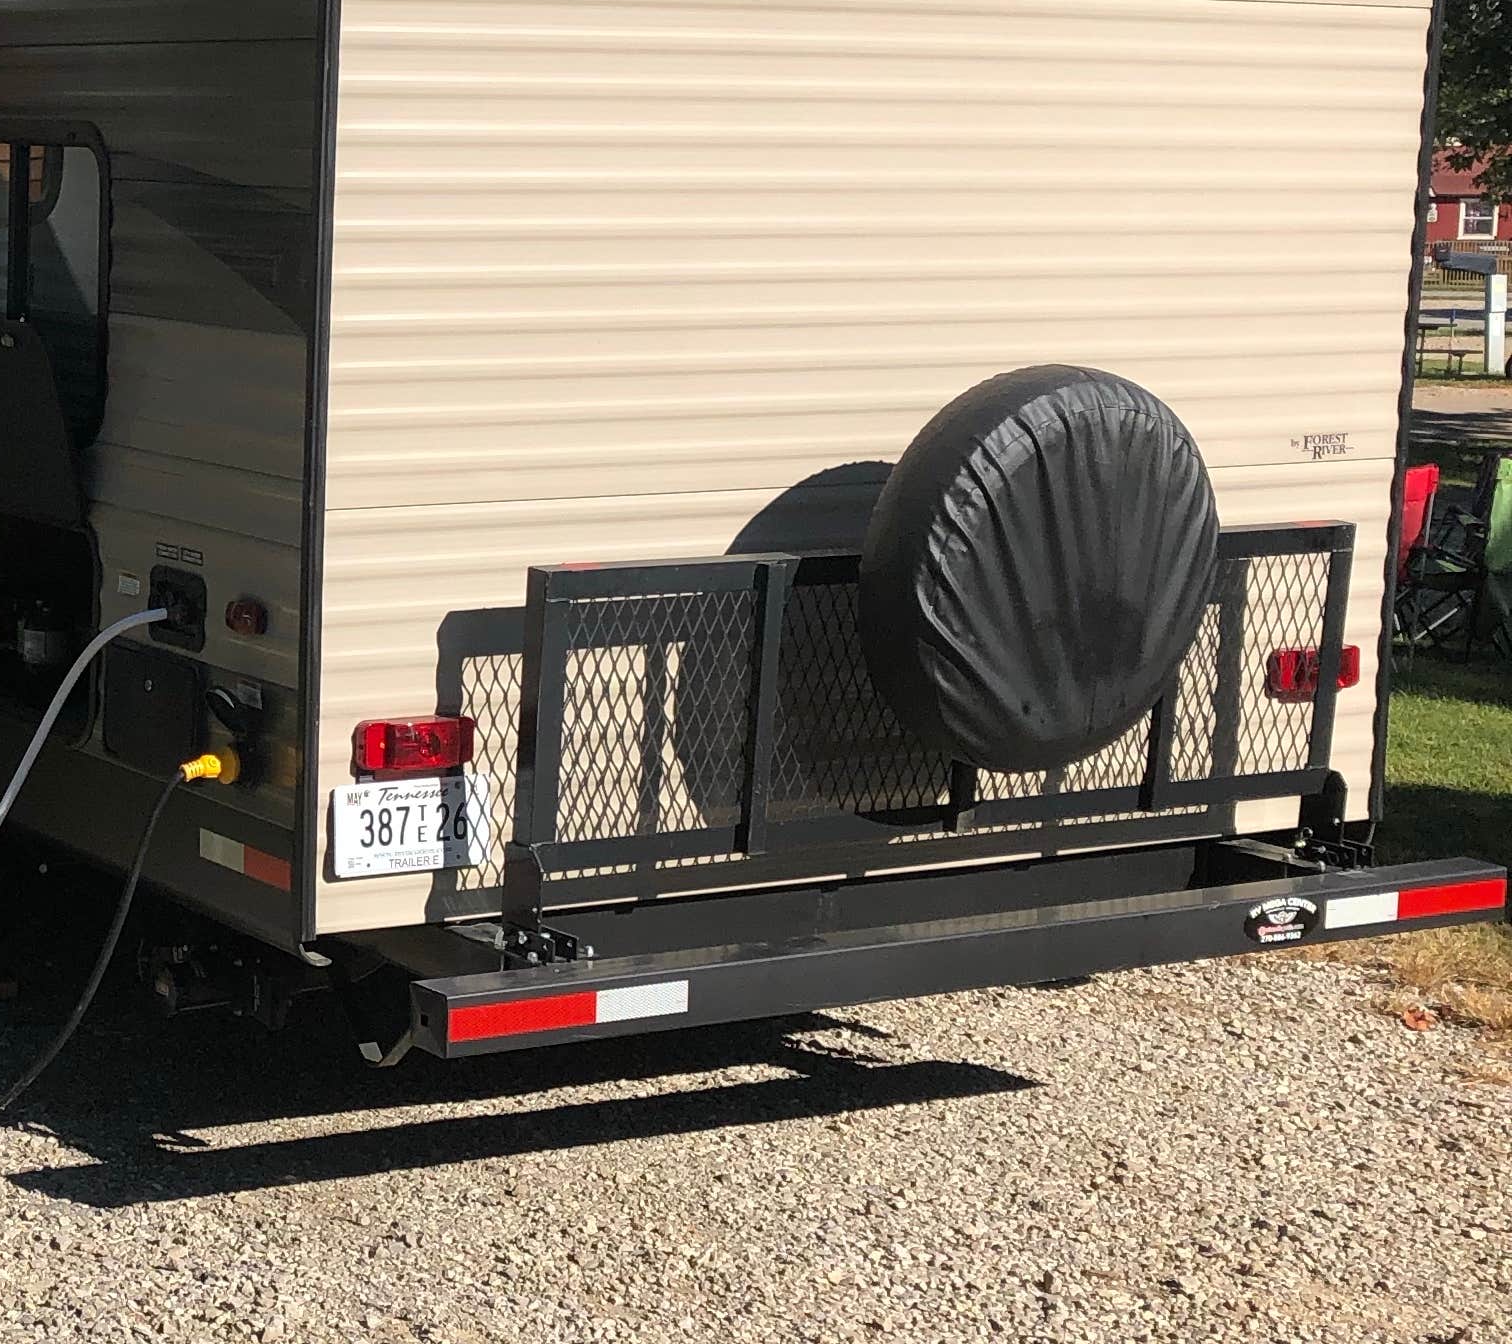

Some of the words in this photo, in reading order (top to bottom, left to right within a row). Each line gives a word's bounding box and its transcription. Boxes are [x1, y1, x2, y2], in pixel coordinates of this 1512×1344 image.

[1290, 439, 1300, 449] by
[1303, 433, 1349, 450] FOREST
[1312, 444, 1346, 459] RIVER
[347, 792, 362, 807] MAY
[377, 786, 449, 806] Tennessee
[359, 806, 410, 848] 387
[436, 802, 468, 842] 26
[389, 855, 431, 869] TRAILER
[432, 854, 440, 865] E
[1287, 897, 1318, 915] CENTER
